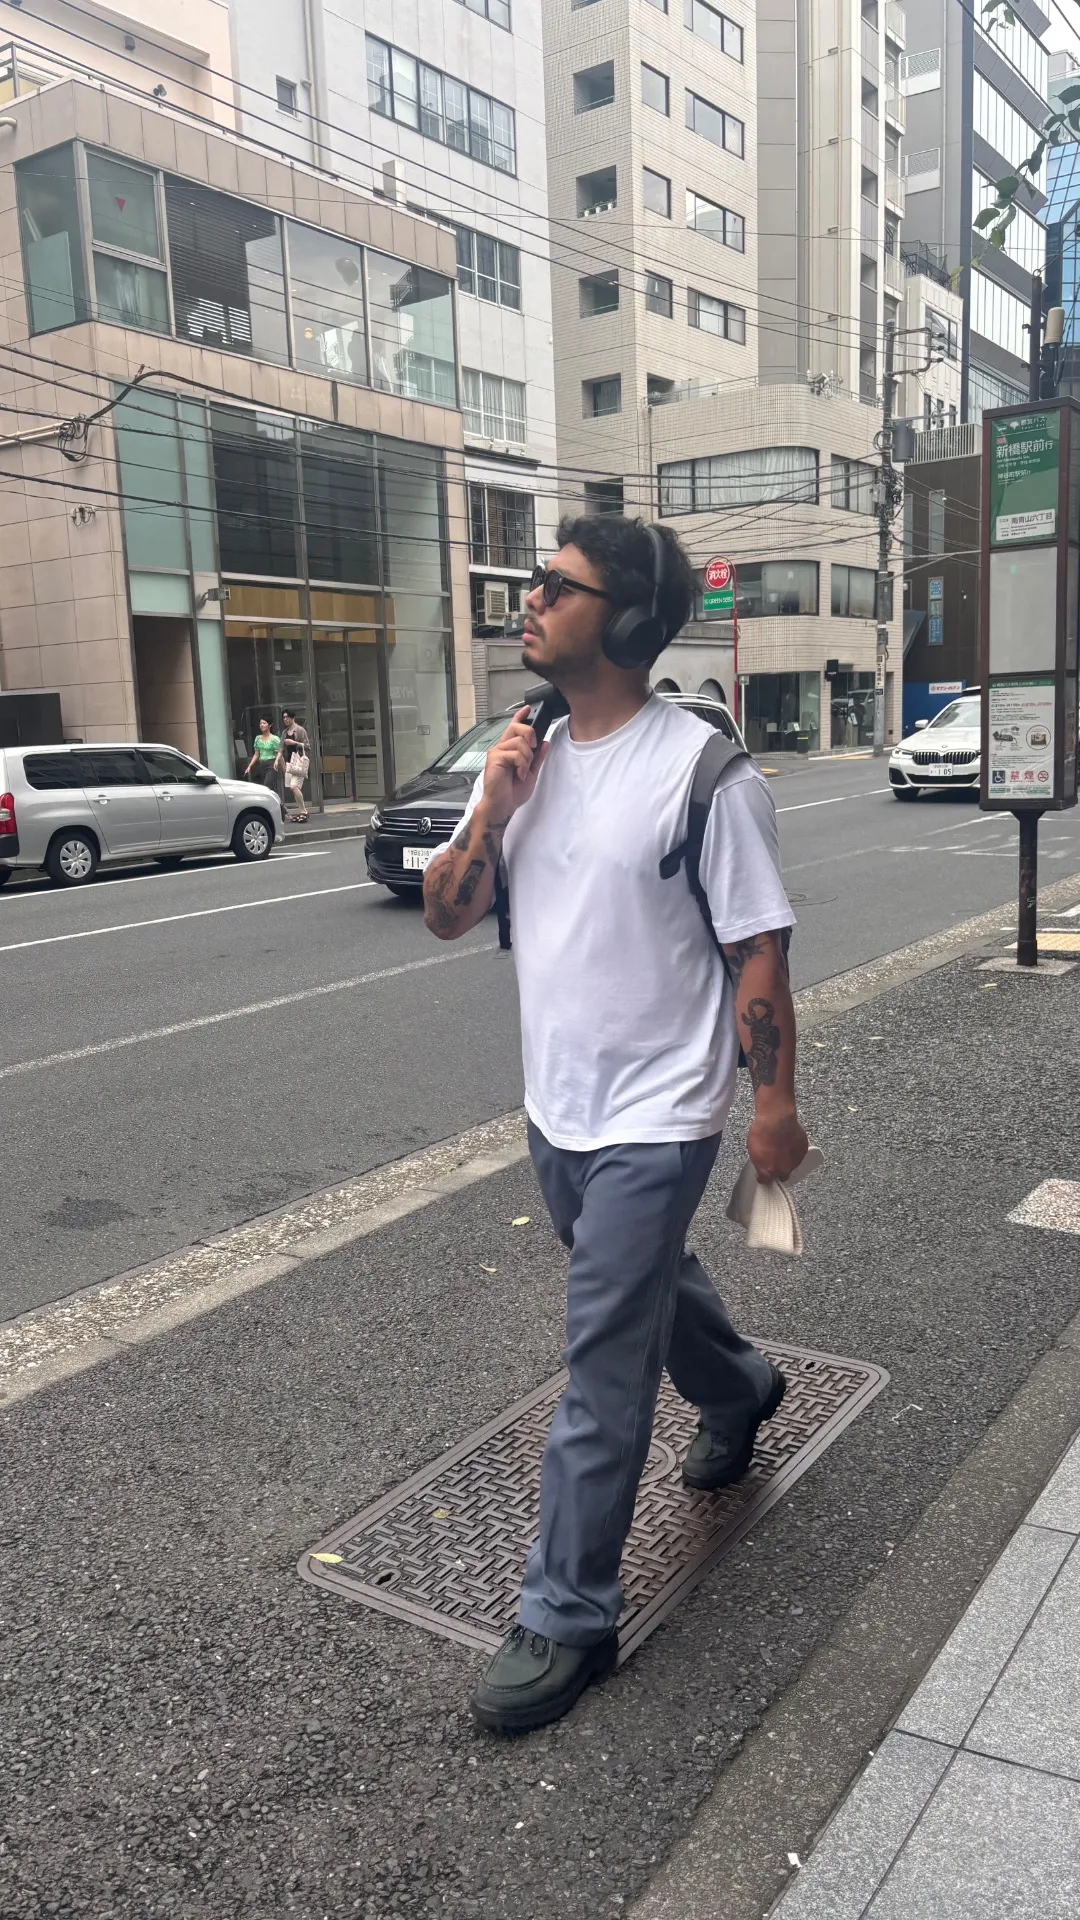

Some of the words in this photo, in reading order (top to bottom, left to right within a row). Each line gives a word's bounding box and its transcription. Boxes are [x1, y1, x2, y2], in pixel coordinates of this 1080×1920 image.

[996, 439, 1054, 458] 新橋駅前行
[709, 568, 728, 580] 消火栓
